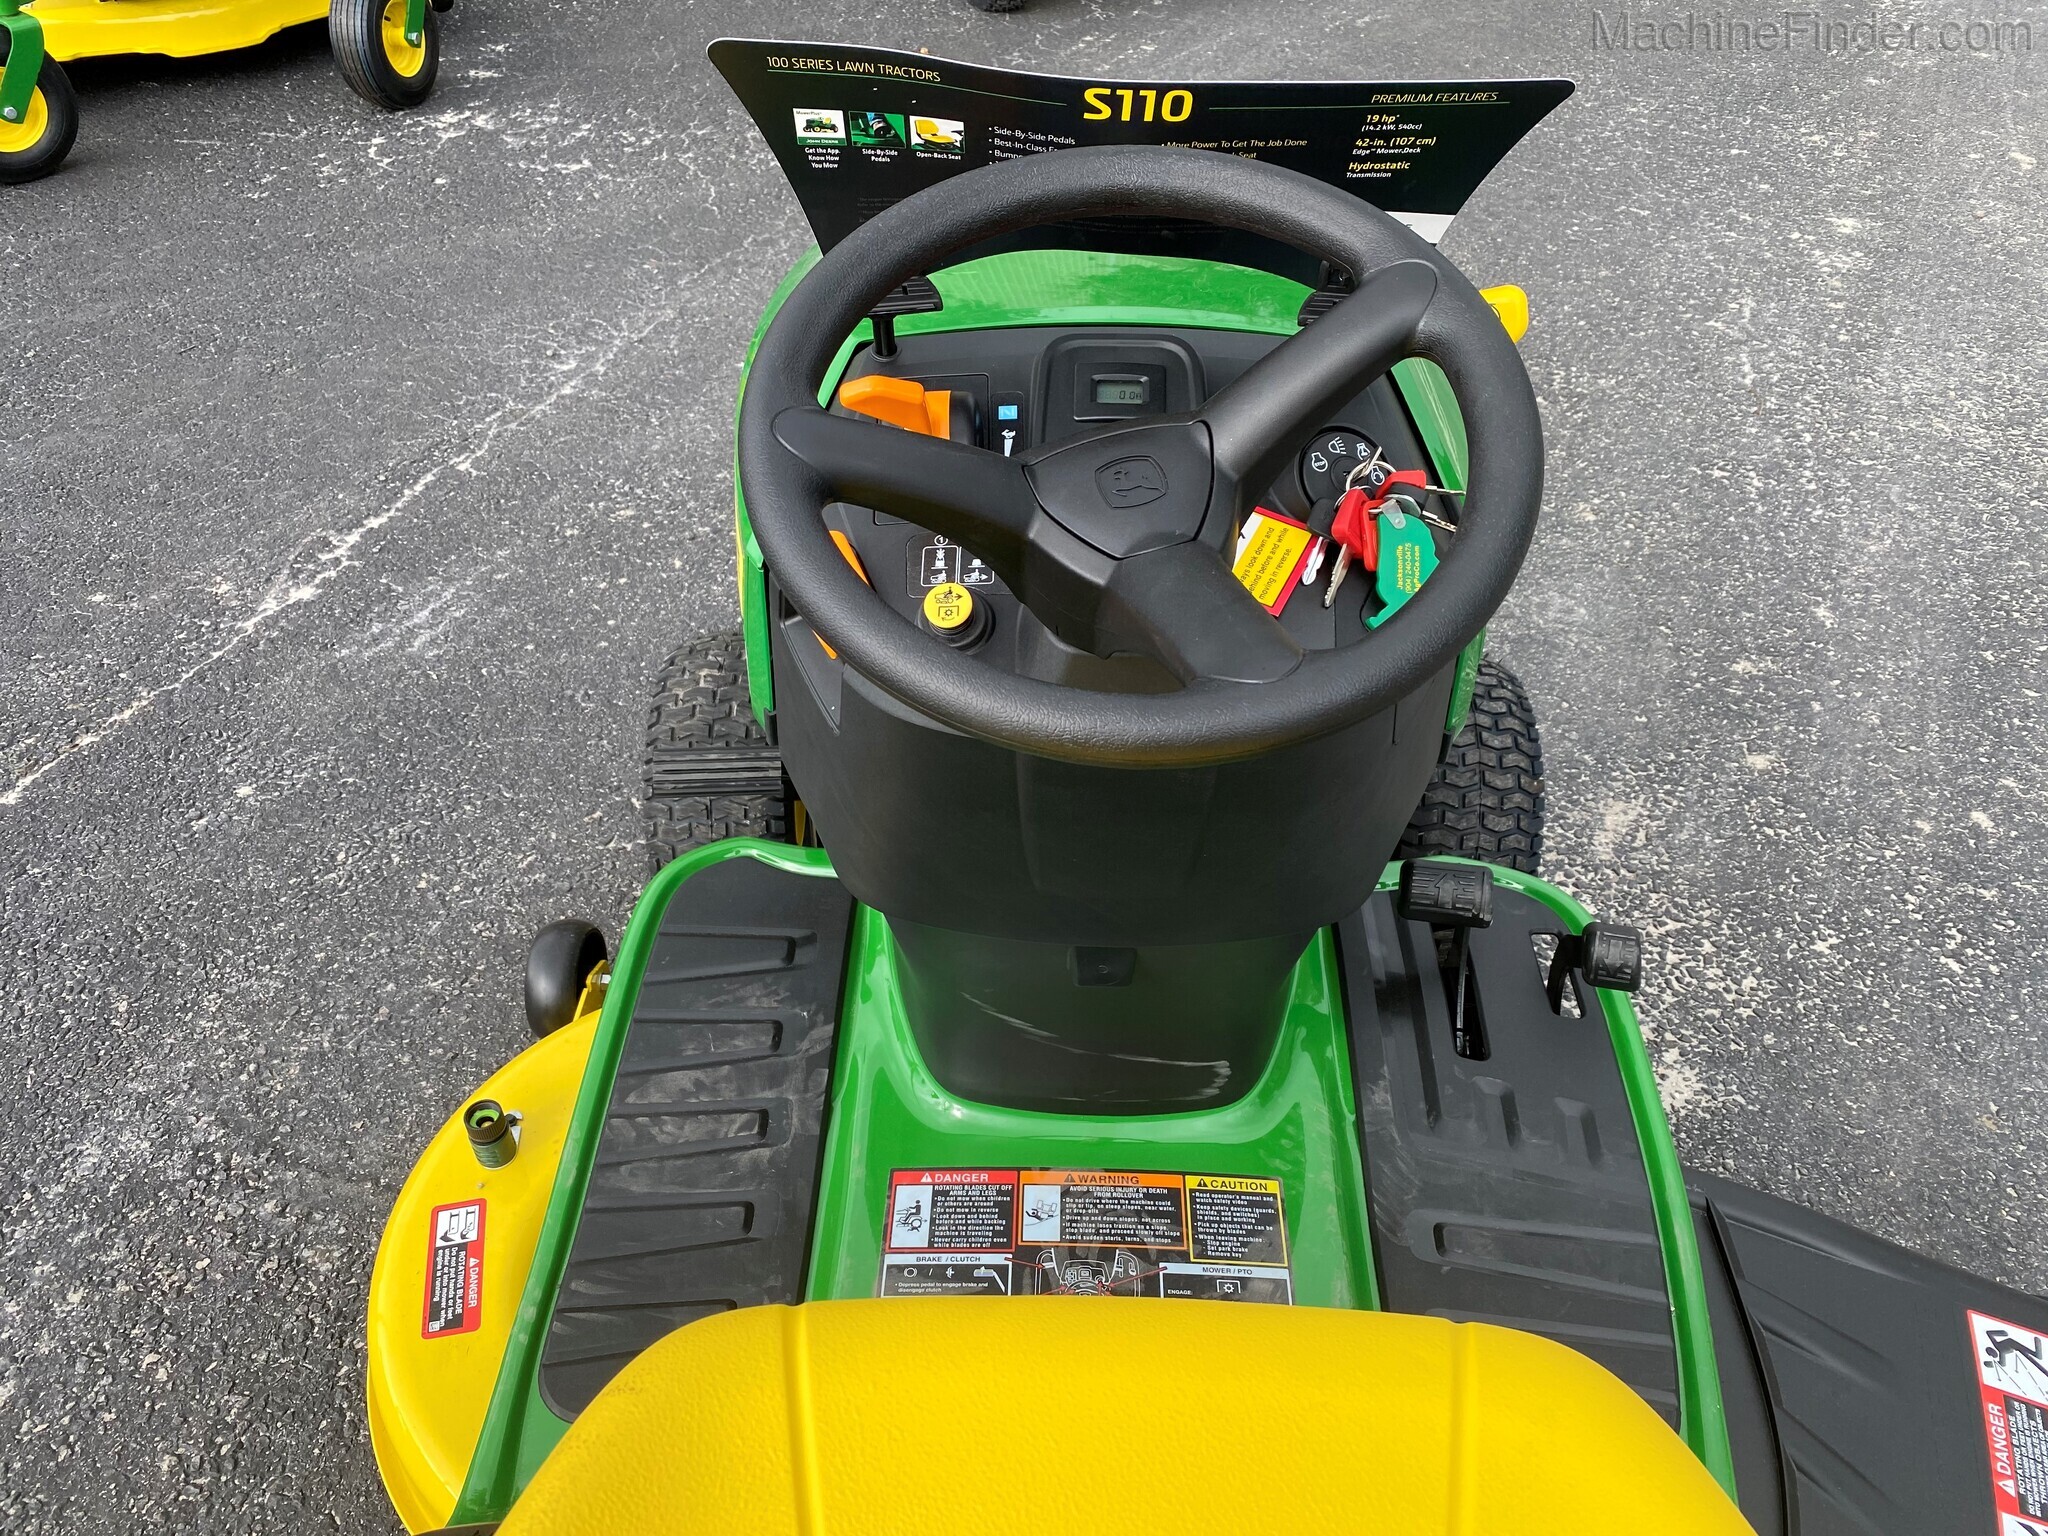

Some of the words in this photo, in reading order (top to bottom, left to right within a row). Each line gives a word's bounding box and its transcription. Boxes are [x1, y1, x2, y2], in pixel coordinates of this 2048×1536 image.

[767, 57, 788, 68] 100
[792, 58, 834, 70] SERIES
[837, 61, 874, 74] LAWN
[878, 64, 941, 82] TRACTORS
[1083, 88, 1193, 122] S110
[1371, 94, 1433, 104] PREMIUM
[1435, 92, 1499, 102] FEATURES
[994, 126, 1046, 141] Side-By-Side
[1048, 134, 1076, 145] Pedals
[994, 138, 1047, 153] Best-In-Class
[1355, 138, 1387, 147] 42-in.
[1390, 136, 1415, 147] (107
[1416, 136, 1436, 146] cm)
[1349, 161, 1410, 171] Hydrostatic
[1246, 556, 1258, 568] look
[1255, 539, 1267, 555] down
[1265, 527, 1274, 538] and
[1249, 574, 1261, 594] ehind
[1259, 556, 1273, 574] before
[1270, 543, 1279, 555] and
[1277, 528, 1289, 543] while
[1259, 578, 1276, 600] moving
[1276, 548, 1292, 570] reverse.
[934, 1174, 988, 1182] DANGER
[1078, 1175, 1139, 1184] WARNING
[1211, 1180, 1268, 1191] CAUTION
[451, 1247, 458, 1256] Do
[456, 1251, 466, 1288] ROTATING
[433, 1277, 441, 1302] running
[468, 1267, 479, 1308] DANGER
[455, 1289, 463, 1314] BLADE
[1987, 1402, 2012, 1476] DANGER
[2009, 1415, 2019, 1445] BLADE
[2029, 1420, 2042, 1461] OBJECTS
[2014, 1447, 2026, 1495] ROTATING
[2035, 1462, 2047, 1503] THROWN
